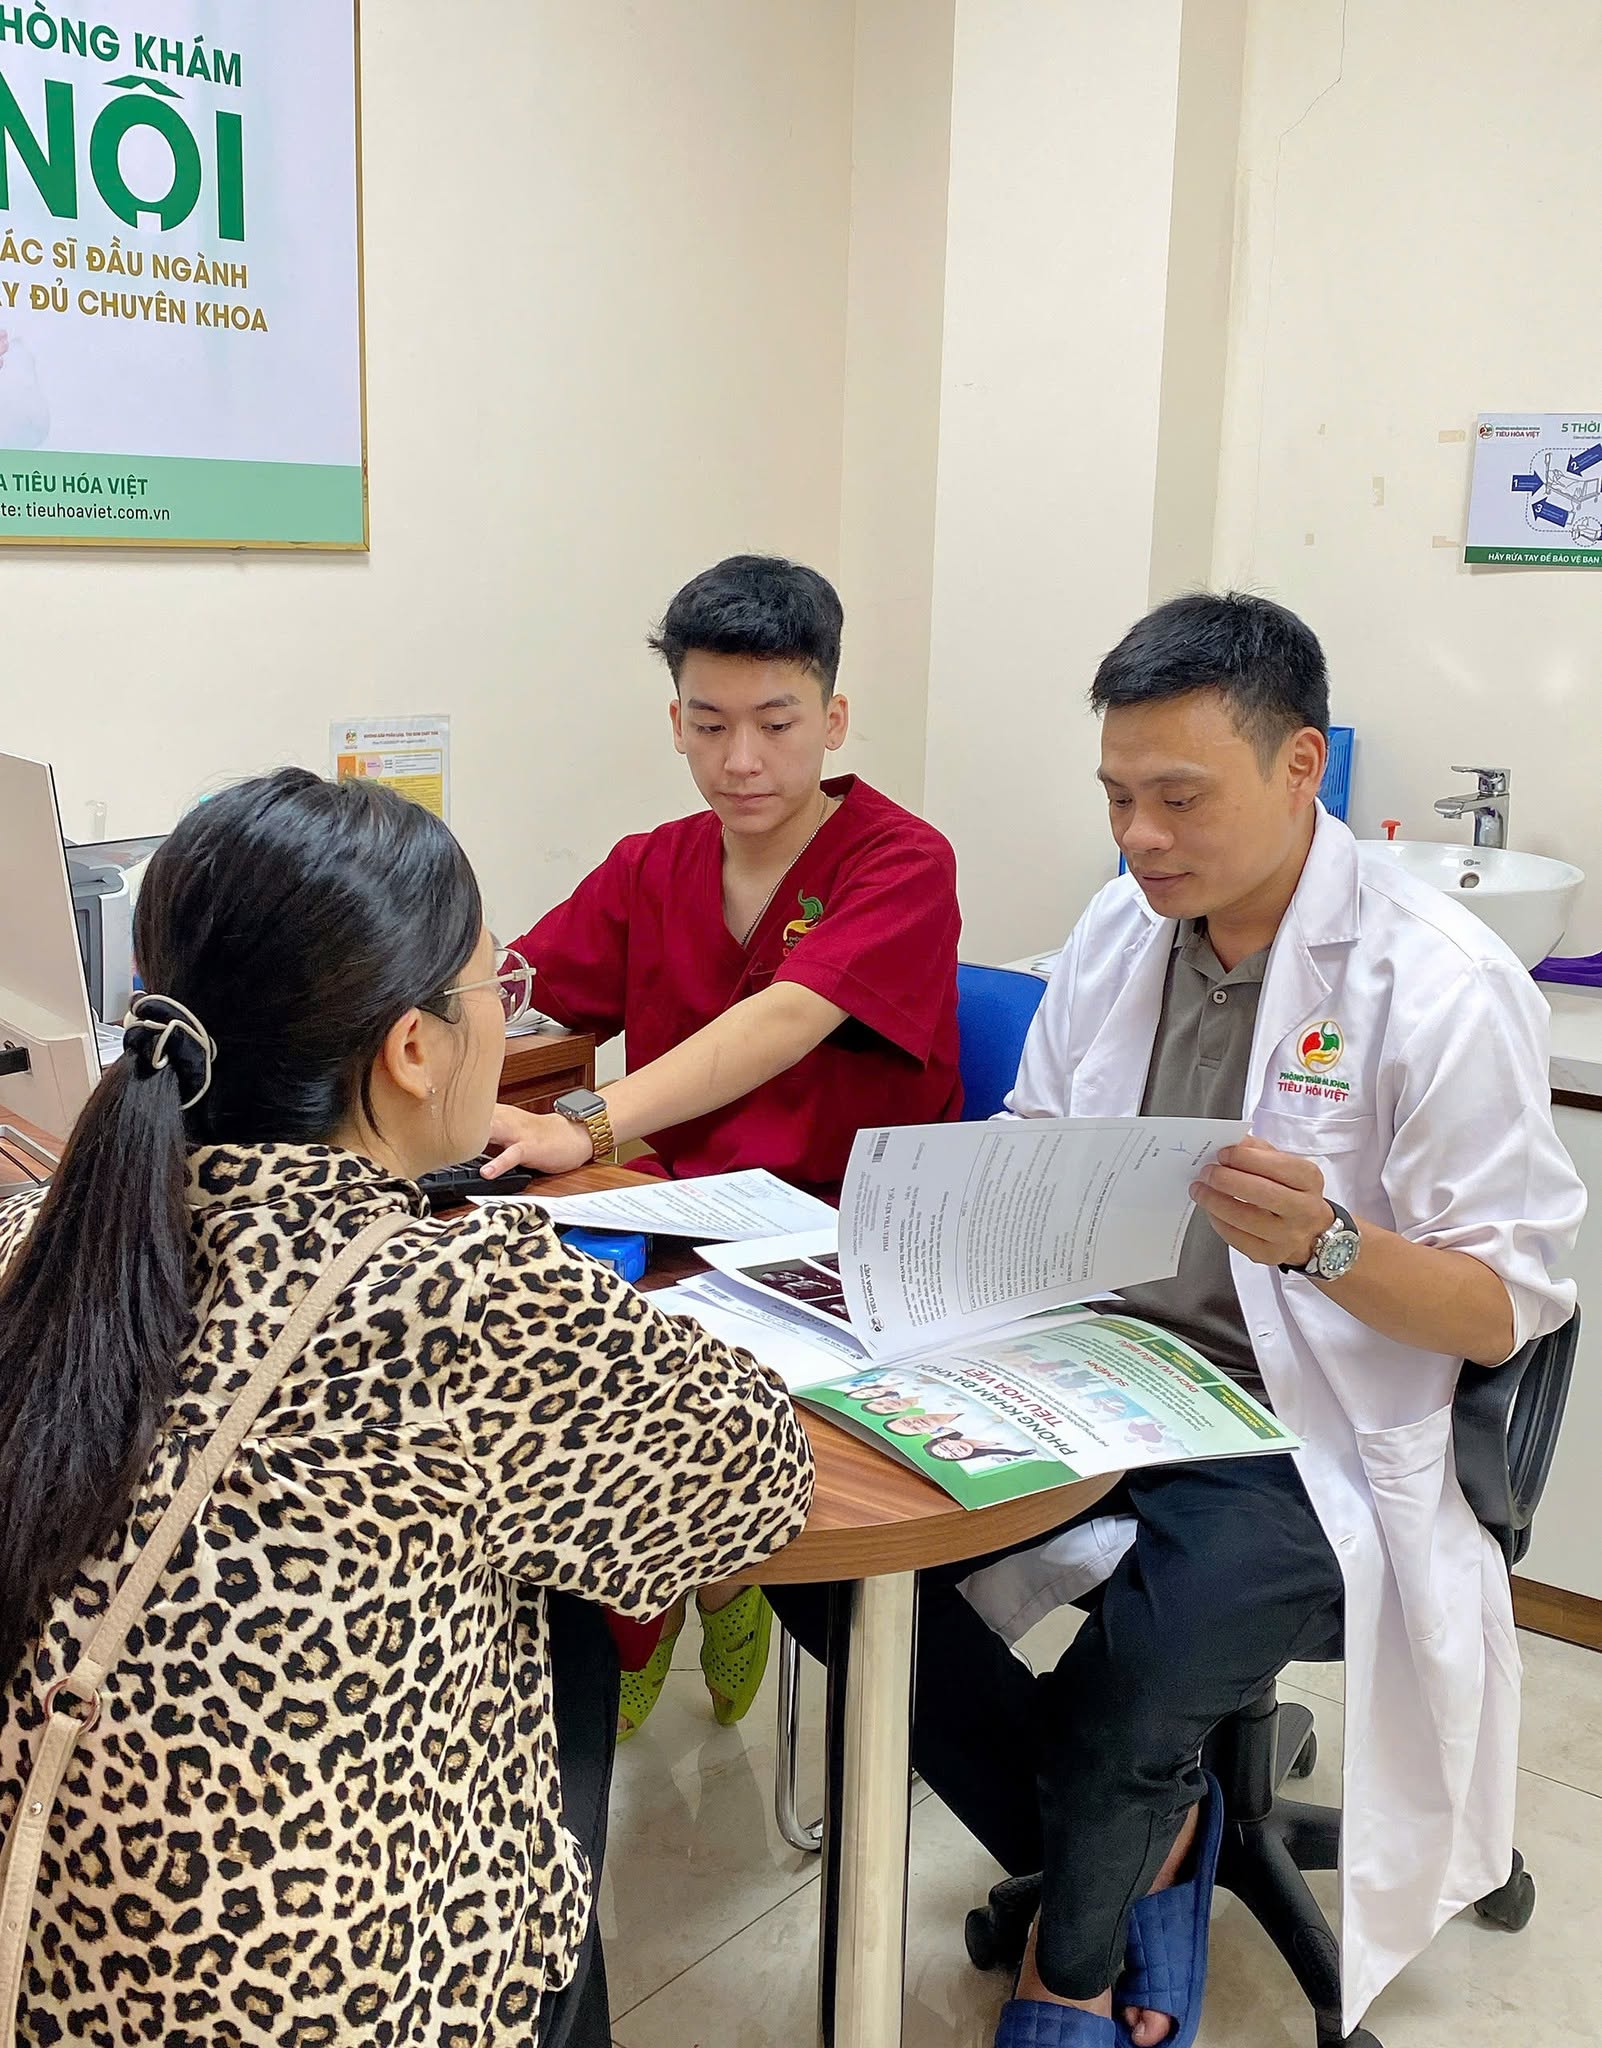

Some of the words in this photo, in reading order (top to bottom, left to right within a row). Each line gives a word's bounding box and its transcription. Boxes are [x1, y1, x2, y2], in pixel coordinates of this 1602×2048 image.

[134, 35, 242, 87] KHÁM
[53, 237, 78, 269] SĨ
[86, 235, 143, 277] ĐẦU
[152, 252, 248, 289] NGÀNH
[29, 277, 68, 313] ĐỦ
[78, 290, 186, 324] CHUYÊN
[195, 301, 268, 332] KHOA
[1561, 423, 1568, 433] 5
[1571, 461, 1579, 470] 2
[12, 470, 56, 492] TIÊU
[63, 472, 103, 494] HÓA
[107, 474, 148, 499] VIỆT
[1513, 479, 1518, 487] 1
[26, 502, 170, 520] tieuhoaviet.com.vn
[1535, 504, 1543, 513] 3
[1582, 556, 1600, 565] BẠN
[1277, 1081, 1302, 1093] TIÊU
[1324, 1088, 1349, 1102] VIỆT
[953, 1376, 979, 1389] ĐA
[960, 1368, 996, 1385] VIỆT
[973, 1386, 1024, 1416] KHÁM
[994, 1382, 1031, 1404] HÓA
[1024, 1403, 1063, 1428] TIÊU
[1017, 1416, 1078, 1456] PHÒNG
